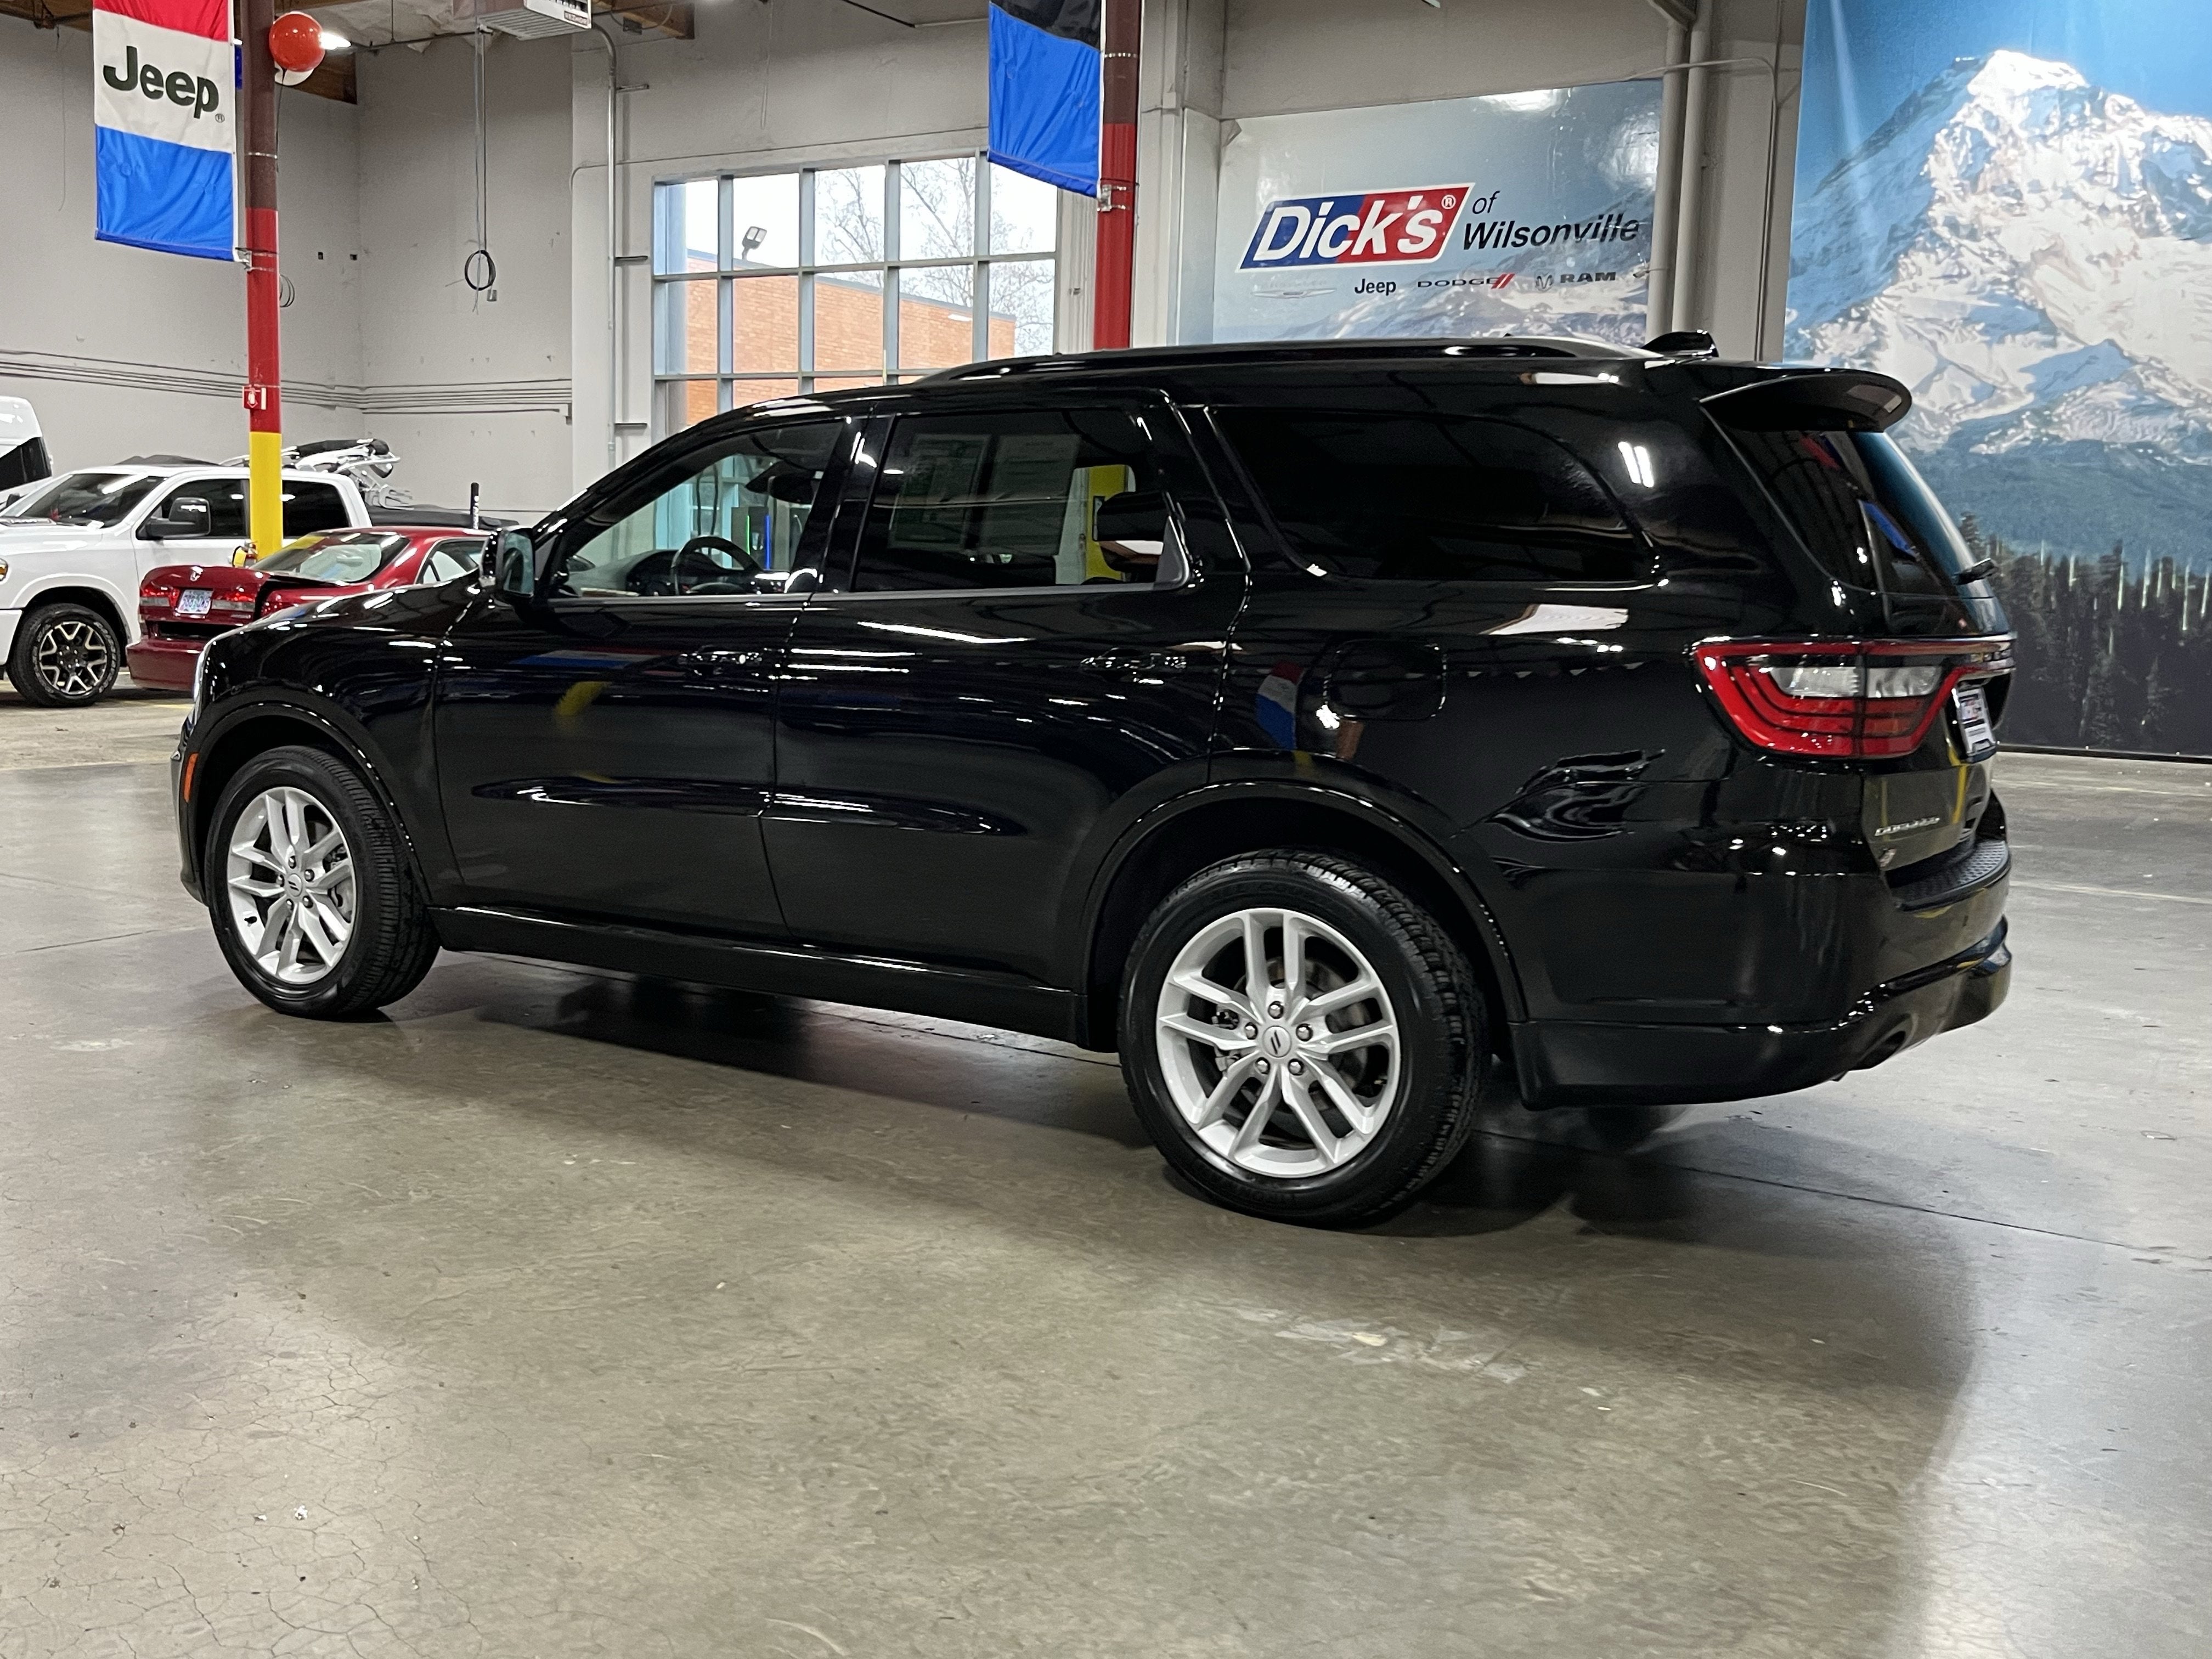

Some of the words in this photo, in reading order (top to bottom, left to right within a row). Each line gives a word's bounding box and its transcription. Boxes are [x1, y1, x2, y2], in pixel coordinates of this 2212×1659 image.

[1471, 190, 1500, 215] of
[1463, 211, 1640, 250] Wilsonville
[1354, 278, 1396, 296] Jeep
[1417, 276, 1499, 288] DODGE
[1560, 272, 1617, 284] RAM
